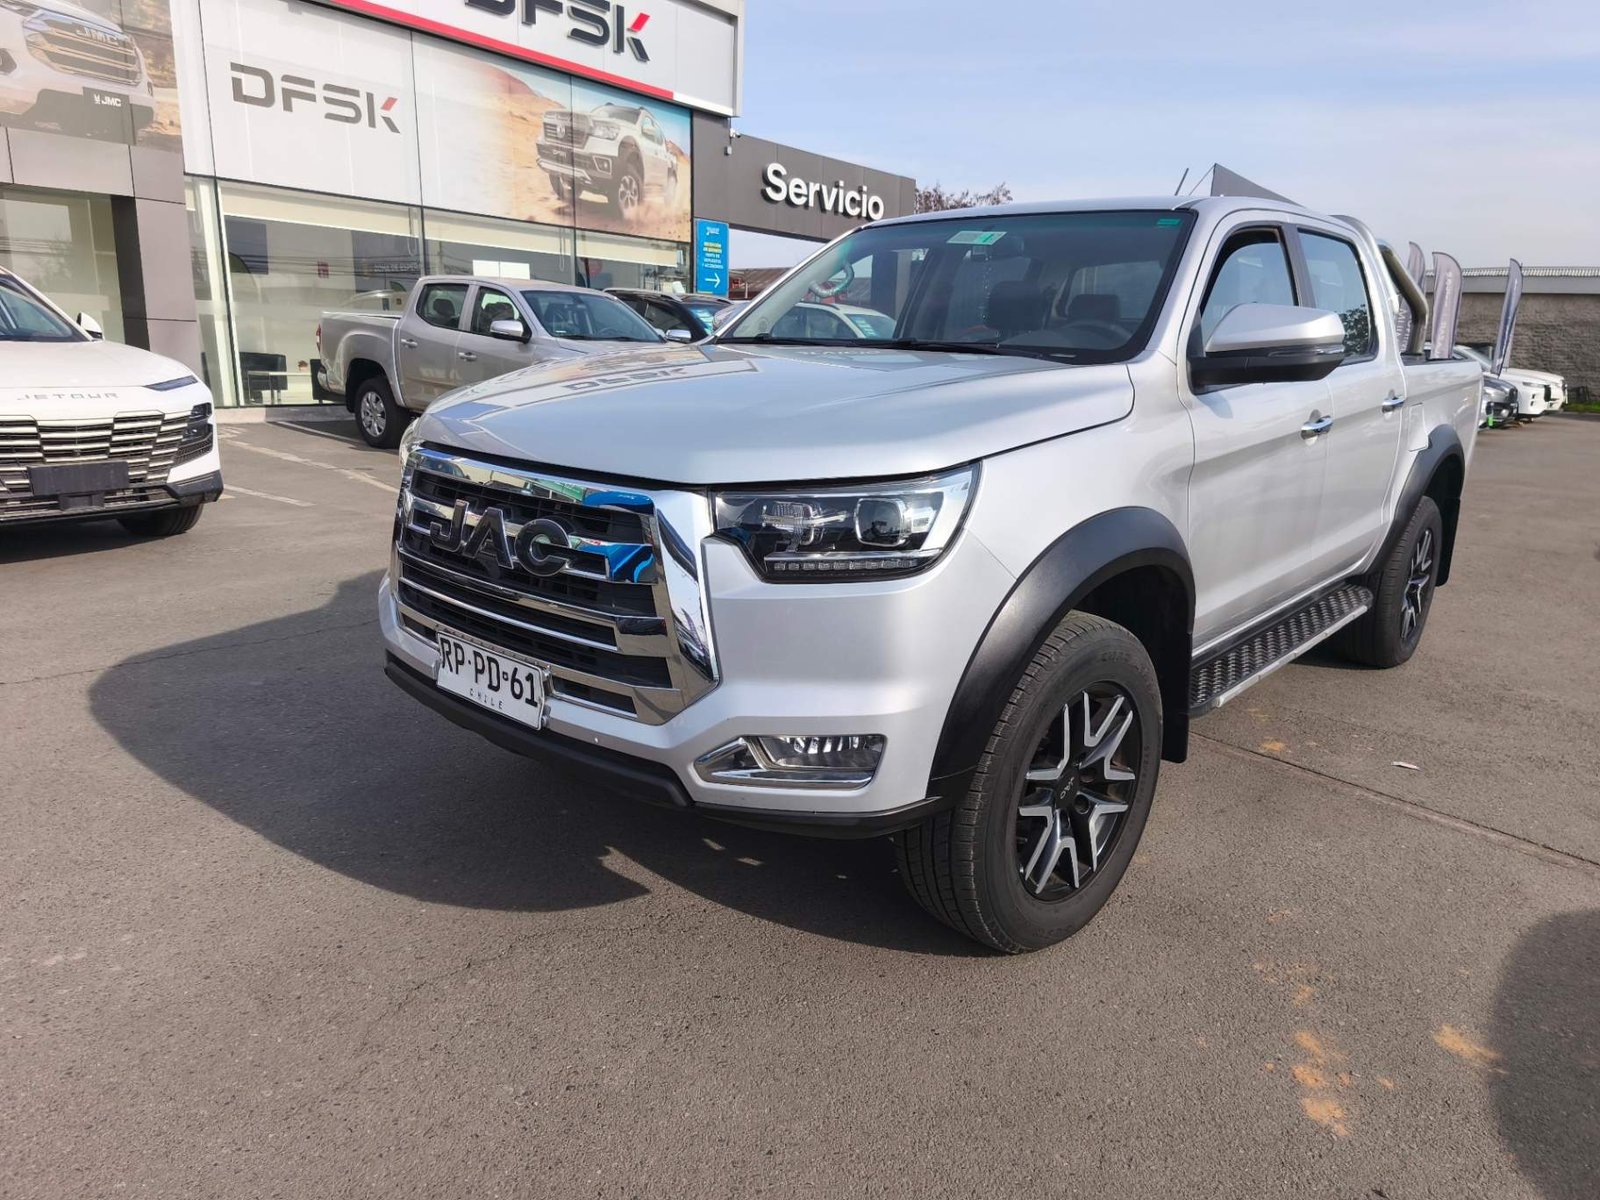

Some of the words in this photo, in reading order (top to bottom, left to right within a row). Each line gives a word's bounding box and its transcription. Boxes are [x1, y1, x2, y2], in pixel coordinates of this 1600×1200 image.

[101, 96, 122, 107] JMC
[230, 61, 401, 134] DFSK
[763, 162, 884, 221] Servicio
[17, 393, 119, 401] JETOUR
[430, 499, 572, 577] JAC
[469, 688, 504, 709] CHILE
